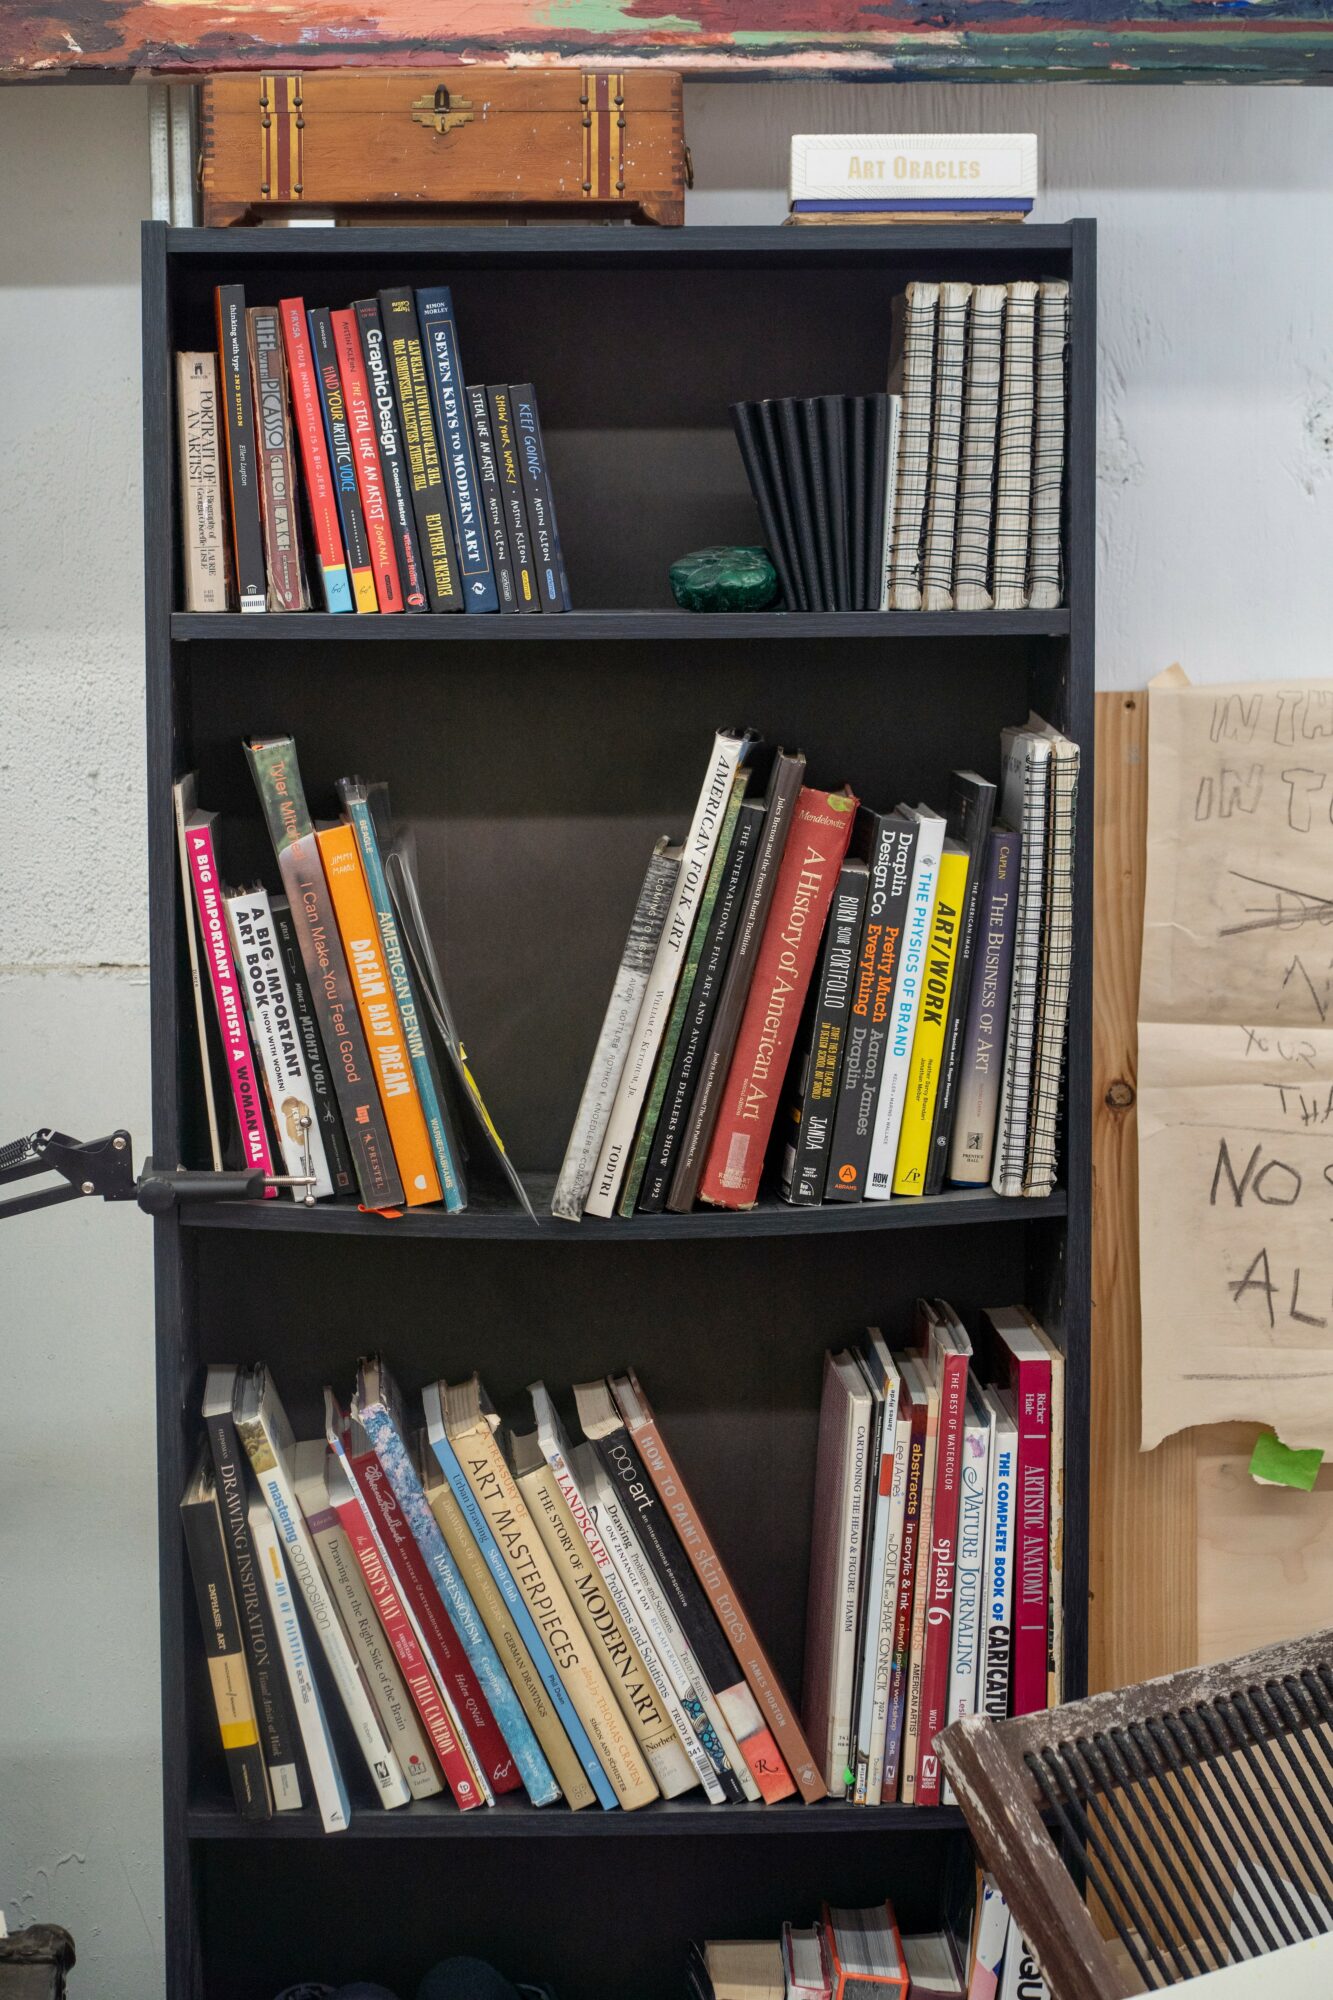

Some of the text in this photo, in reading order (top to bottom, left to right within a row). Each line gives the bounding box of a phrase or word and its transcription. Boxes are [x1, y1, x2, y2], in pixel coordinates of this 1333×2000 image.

[230, 304, 240, 337] thinking
[232, 337, 240, 354] with
[320, 321, 328, 349] CONGDON
[424, 307, 448, 315] MORLEY
[232, 354, 240, 371] type
[235, 393, 243, 427] EDITION
[322, 364, 356, 492] FIND YOUR ARTISTIC VOICE
[434, 331, 480, 562] SEVEN KEYS TO MODERN ART
[472, 393, 495, 484] STEAL LIKE AN ARTIST
[425, 513, 453, 597] EUGENE EHRLICH
[330, 852, 353, 866] JIMMY
[668, 755, 730, 952] AMERICAN FOLK ART
[798, 809, 846, 830] Mendelowitz
[998, 846, 1010, 880] CAPLIN
[869, 830, 896, 917] Design Co.
[891, 832, 913, 897] Draplin
[637, 878, 665, 965] COMING TO LIGHT
[963, 931, 973, 959] IMAGE
[969, 896, 978, 928] AMERICAN
[989, 893, 1009, 926] THE
[193, 837, 263, 1162] A BIG IMPORTANT ARTIST: A WOMANUAL
[236, 911, 269, 1010] ART BOOK
[251, 907, 301, 1077] A BIG IMPORTANT
[378, 911, 426, 1058] AMERICAN DENIM
[660, 824, 752, 1167] THE INTERNATIONAL FINE ART AND ANTIQUE DEALERS SHOW
[743, 846, 827, 1122] A History of American Art
[853, 924, 882, 1016] Everything
[872, 926, 900, 1023] Pretty Much
[893, 872, 932, 1057] THE PHYSICS OF BRAND
[923, 901, 956, 1027] ART/WORK
[979, 931, 1005, 1008] BUSINESS
[350, 939, 411, 1098] DREAM BABY DREAM
[845, 1026, 866, 1090] Draplin
[975, 1039, 993, 1074] ART
[979, 1013, 993, 1034] OF
[856, 1028, 884, 1136] Aaron James
[599, 1144, 622, 1197] TODTRI
[806, 1116, 828, 1150] JANDA
[651, 1177, 663, 1199] 1992
[872, 1172, 888, 1184] HOW
[944, 1372, 960, 1491] THE BEST OF WATERCOLOR
[452, 1473, 490, 1544] Urban Drawing
[608, 1445, 654, 1512] pop art
[220, 1463, 270, 1666] DRAWING INSPIRATION
[267, 1480, 331, 1631] mastering composition
[468, 1459, 579, 1669] ART MASTERPIECES
[608, 1504, 633, 1550] Drawing
[641, 1436, 747, 1644] HOW TO PAINT skin tones
[641, 1514, 688, 1608] an international perspective
[1023, 1465, 1045, 1605] ARTISTIC ANATOMY
[433, 1553, 482, 1646] IMPRESSIONISM
[488, 1547, 518, 1603] Sketch Club
[537, 1486, 663, 1726] THE STORY OF MODERN ART
[557, 1473, 670, 1700] LANDSCAPE Problems and Solutions
[928, 1539, 955, 1626] splash 6
[328, 1539, 406, 1732] Drawing on the Right Side of the Brain
[503, 1631, 548, 1718] GERMAN DRAWINGS
[296, 1669, 310, 1704] BOB ROSS
[409, 1674, 457, 1756] JULIA CAMERON
[548, 1674, 565, 1705] Phil Dean
[599, 1695, 643, 1787] THOMAS CRAVEN
[645, 1732, 677, 1752] Norbert
